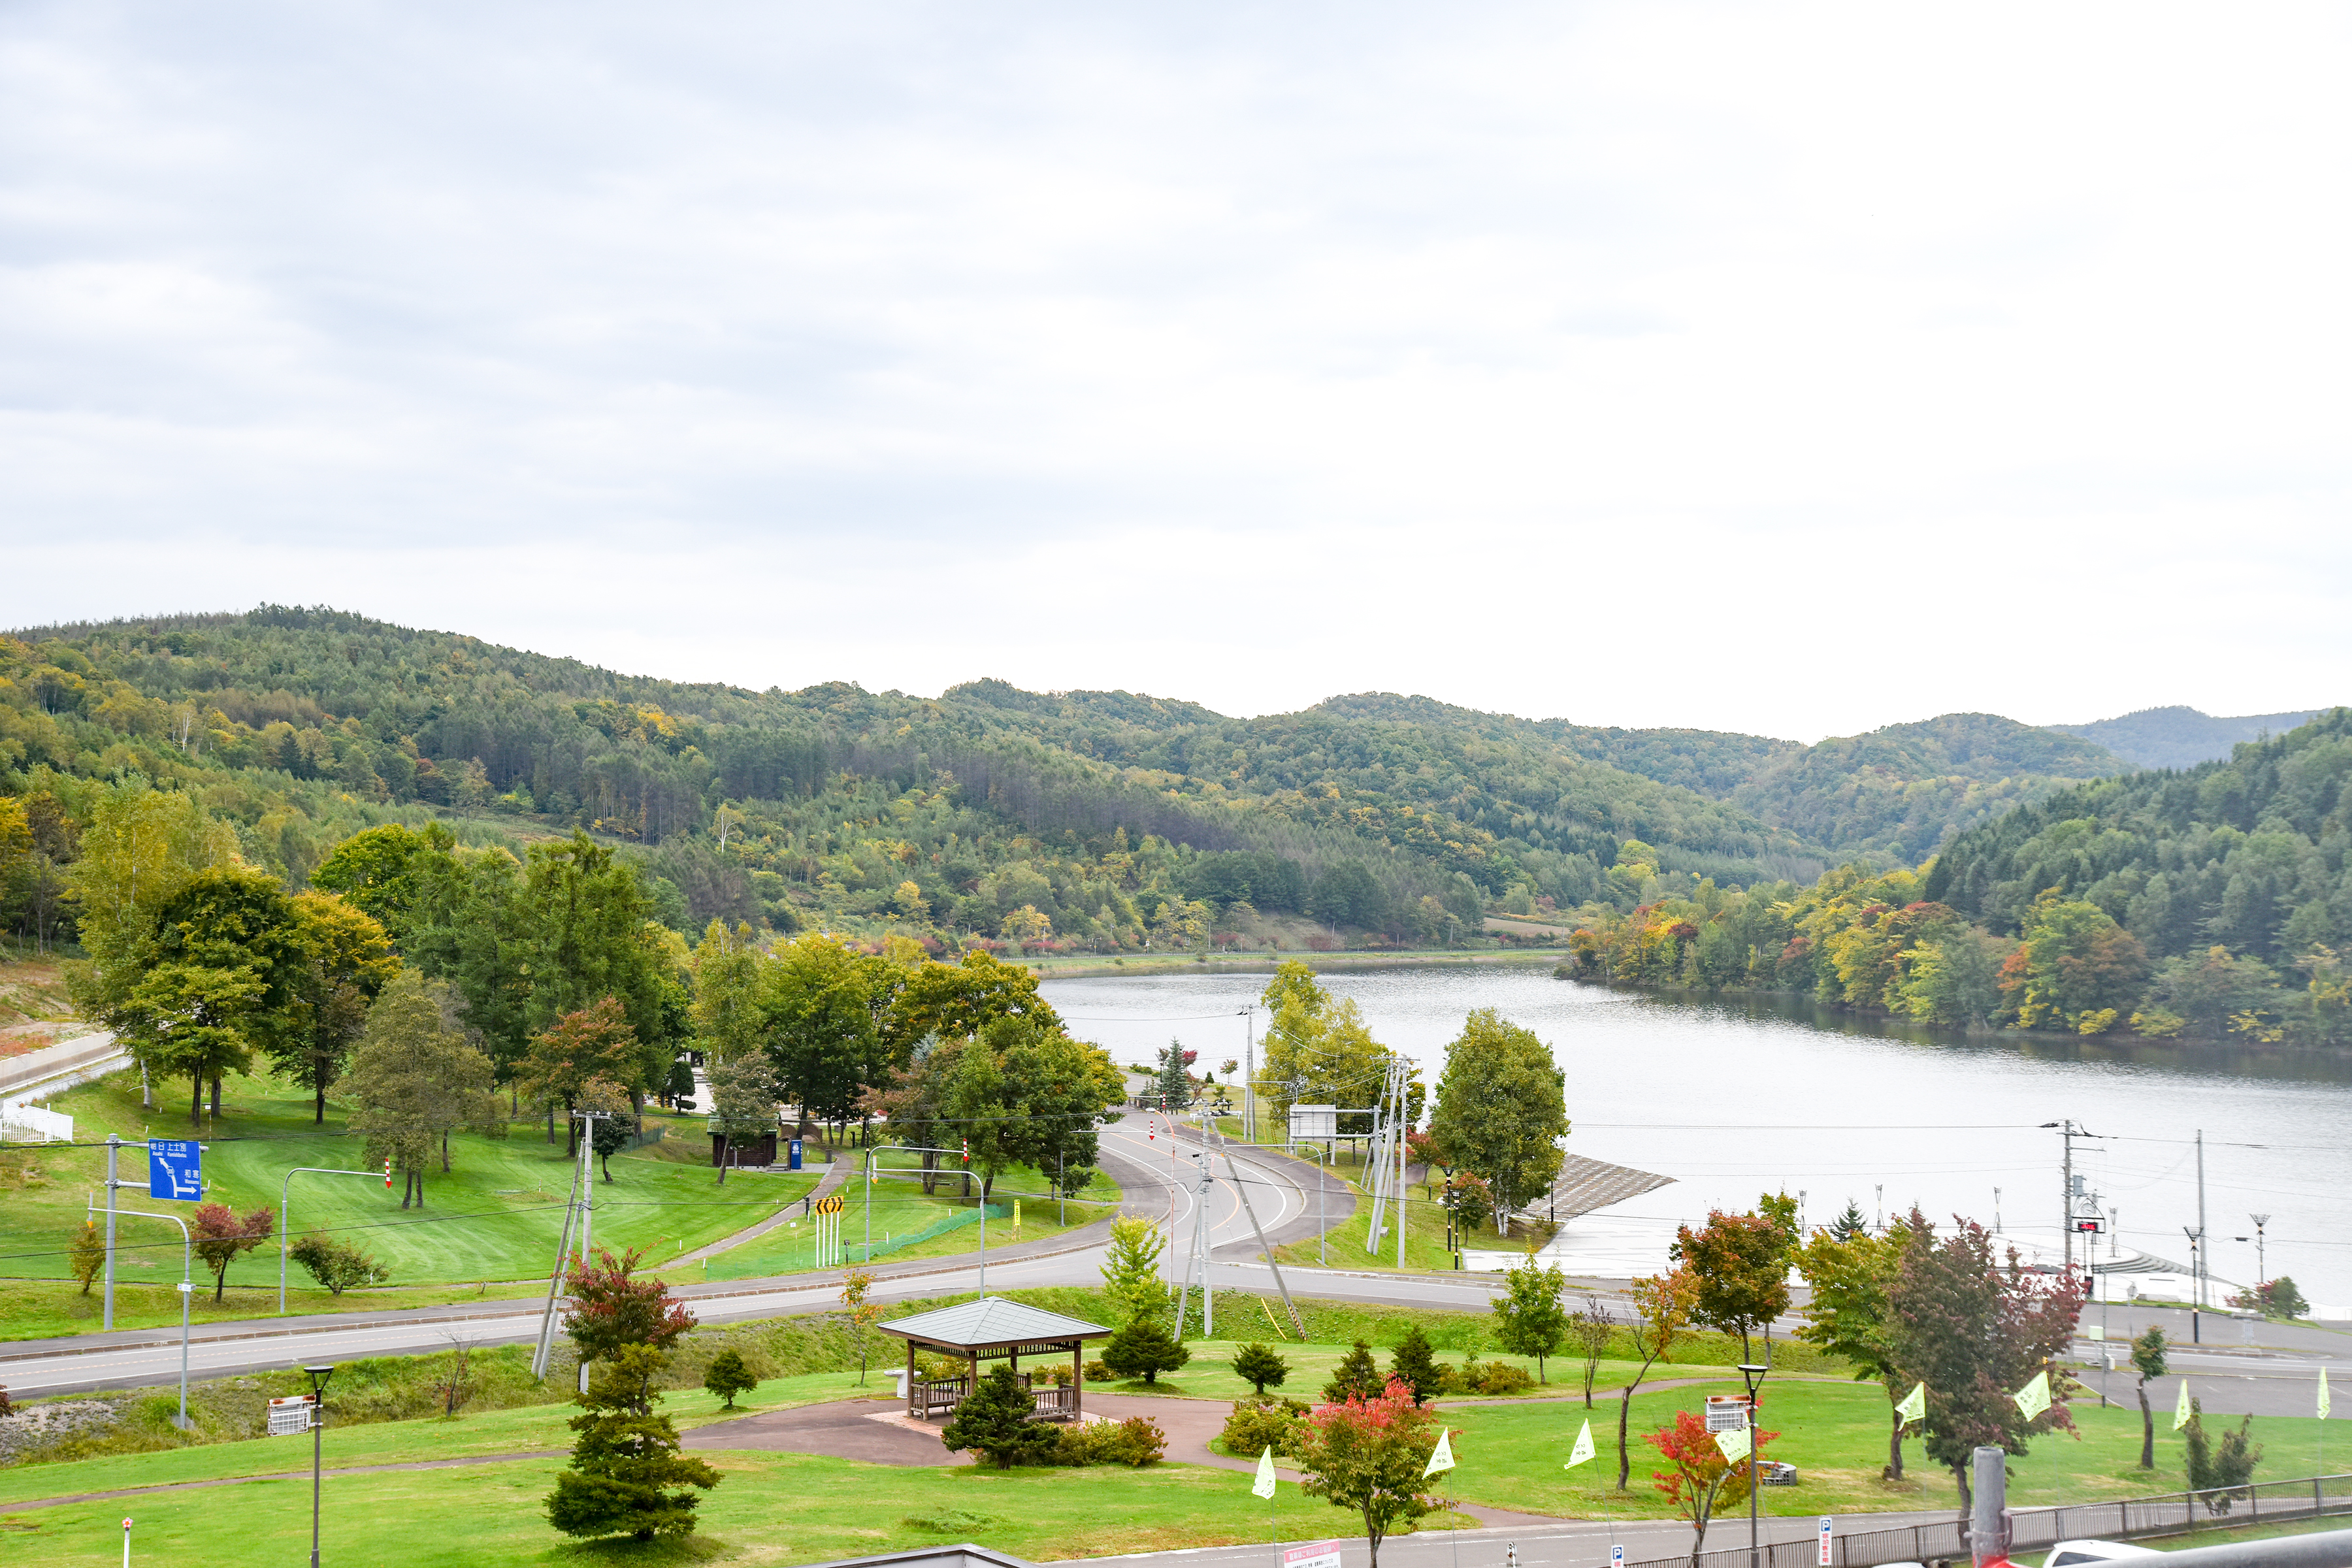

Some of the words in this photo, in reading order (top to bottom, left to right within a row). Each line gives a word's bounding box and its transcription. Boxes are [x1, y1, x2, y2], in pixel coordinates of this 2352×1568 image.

[167, 1143, 186, 1152] 上士別
[184, 1169, 199, 1179] 和寒
[1821, 1520, 1830, 1531] P
[1614, 1548, 1622, 1560] P
